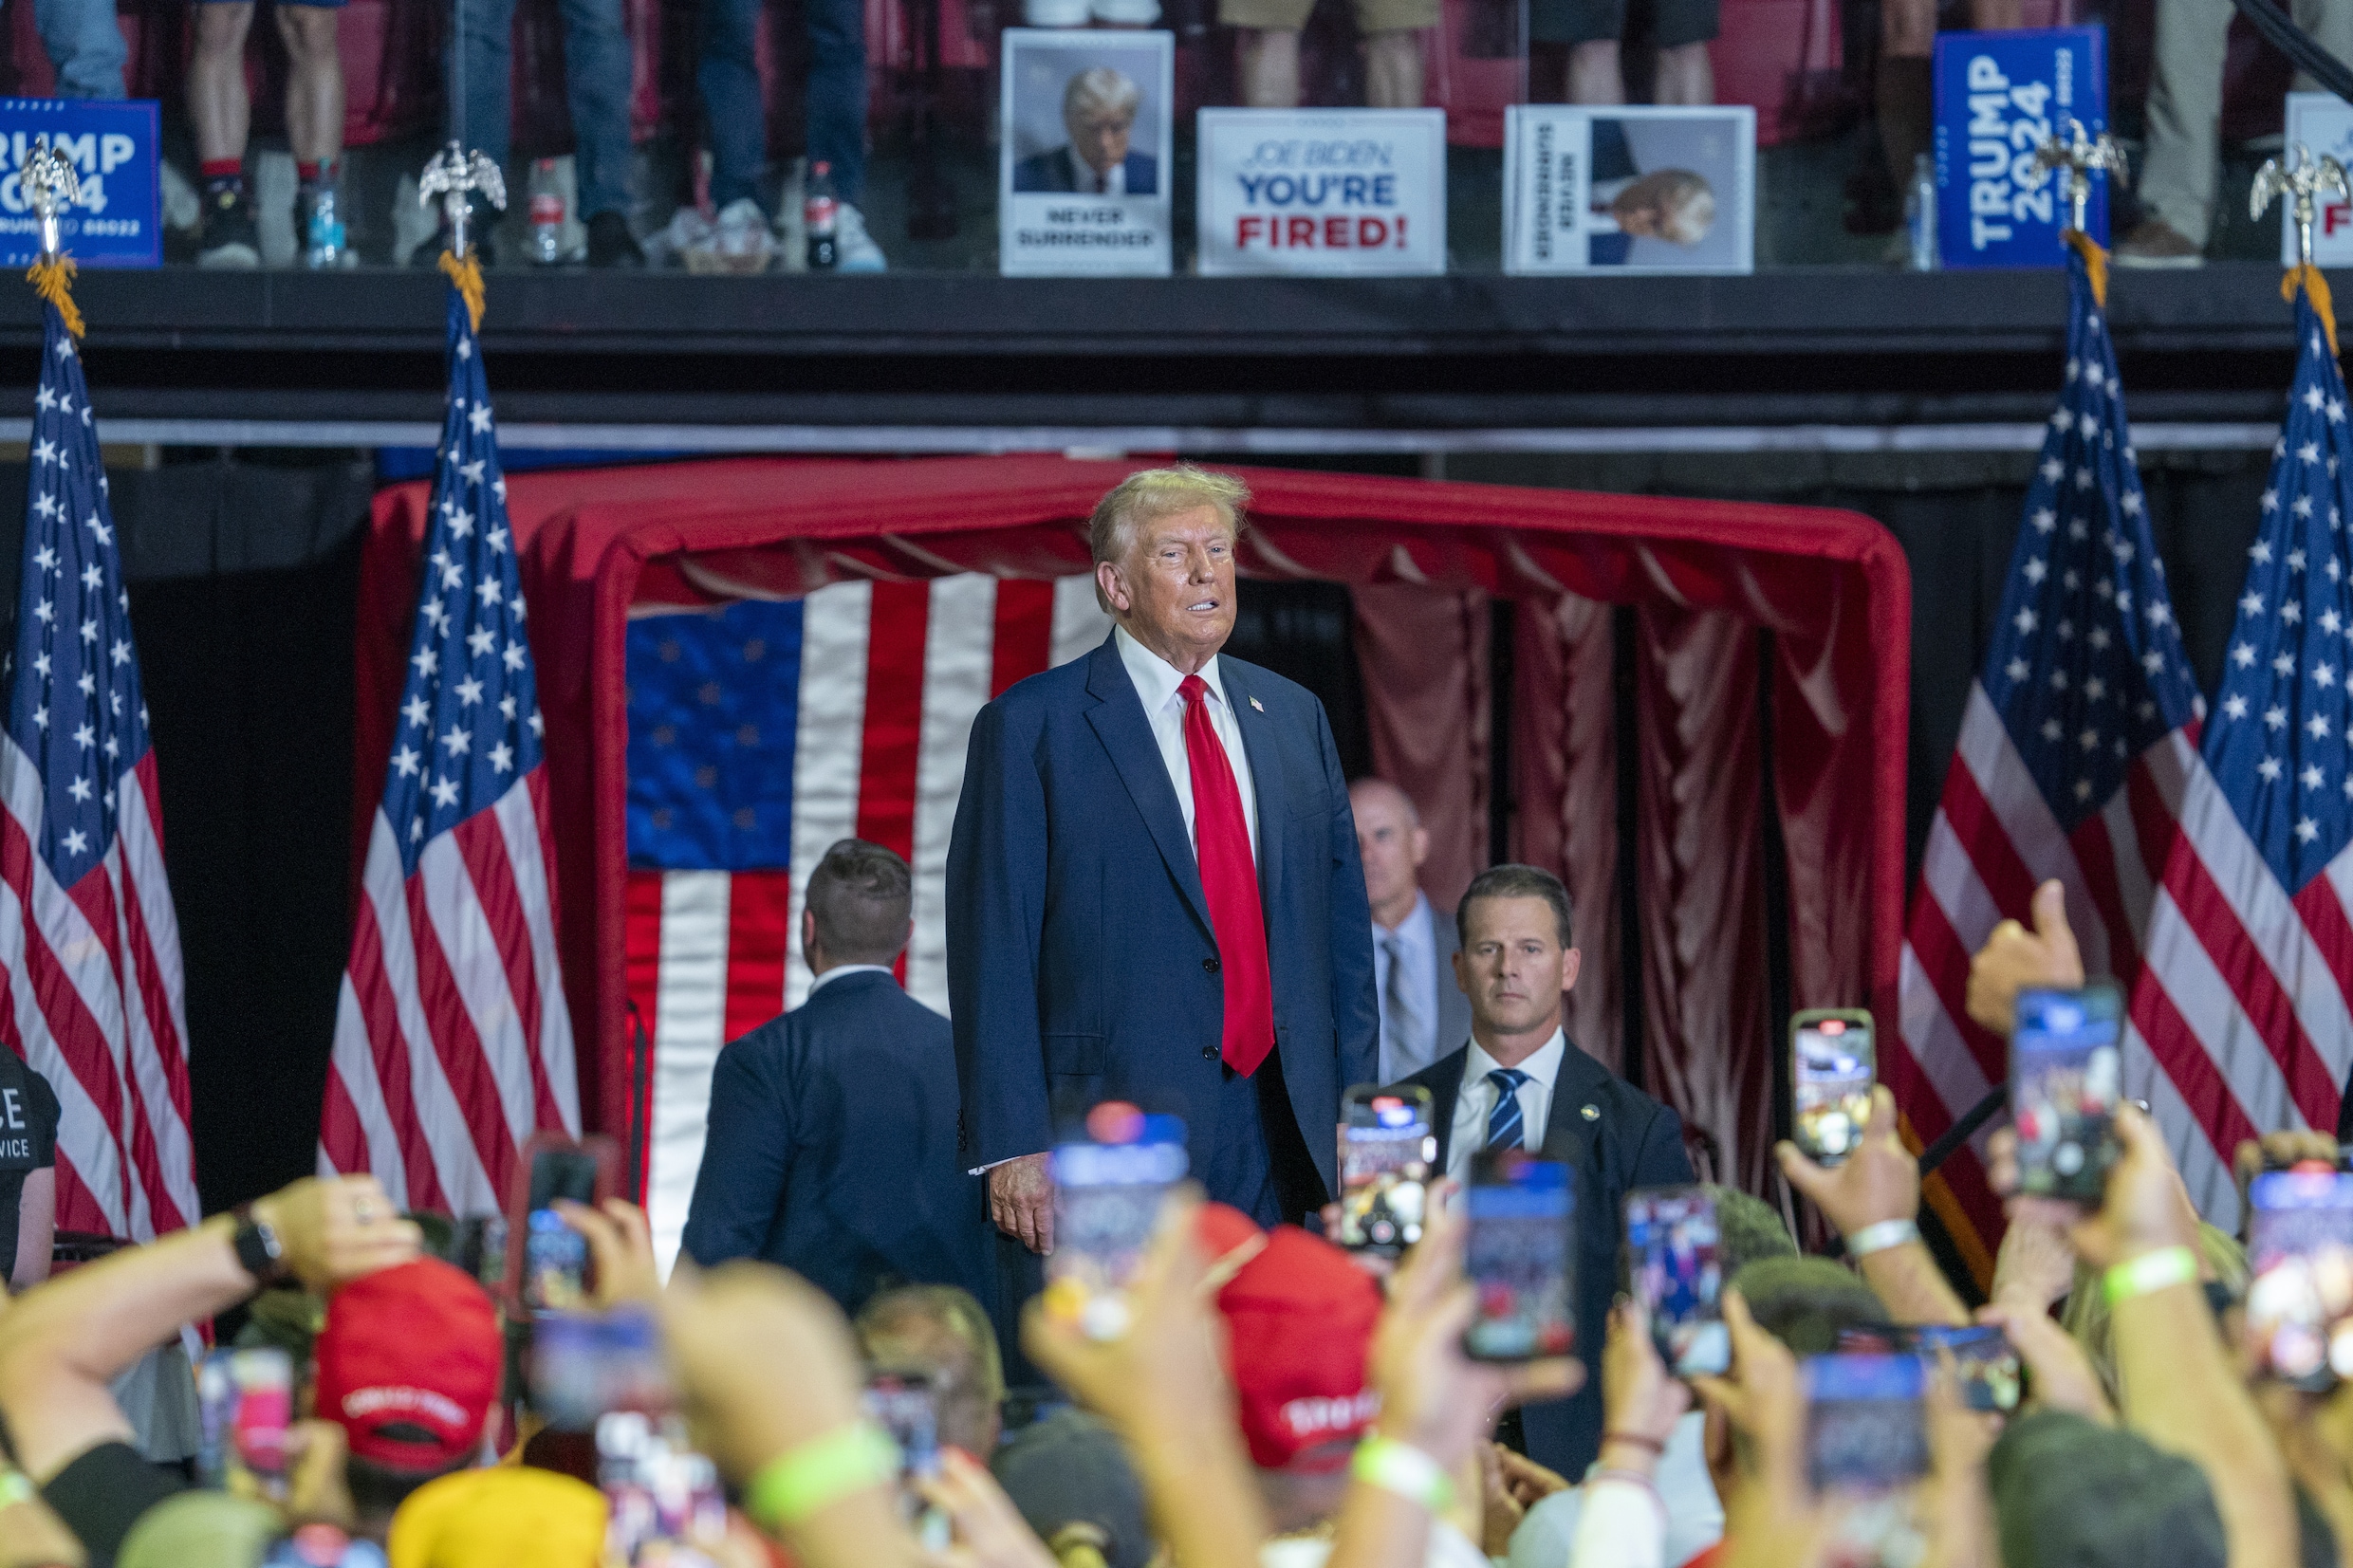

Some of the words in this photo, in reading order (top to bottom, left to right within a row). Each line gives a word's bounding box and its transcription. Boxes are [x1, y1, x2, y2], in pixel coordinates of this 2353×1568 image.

[1241, 139, 1301, 168] JOE
[1967, 55, 2012, 250] TRUMP
[2010, 80, 2052, 224] 2024
[1237, 174, 1398, 207] YOU'RE
[1047, 208, 1123, 223] NEVER
[1017, 231, 1155, 247] SURRENDER
[1237, 216, 1409, 250] FIRED!
